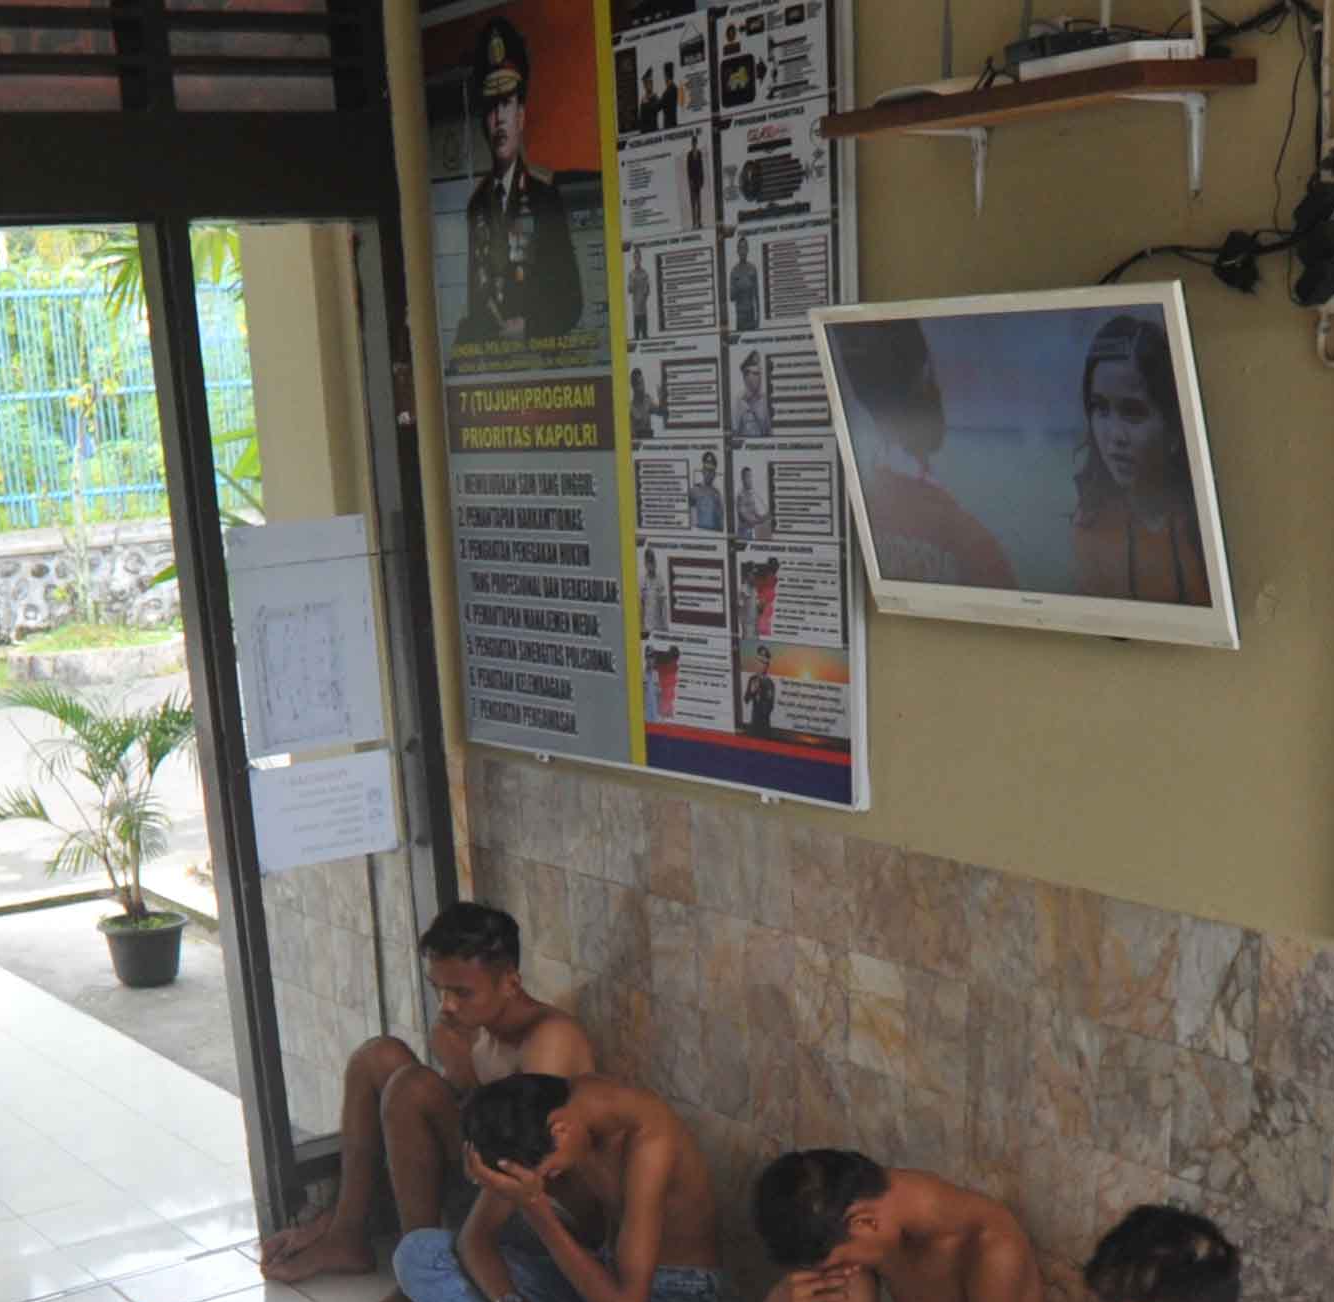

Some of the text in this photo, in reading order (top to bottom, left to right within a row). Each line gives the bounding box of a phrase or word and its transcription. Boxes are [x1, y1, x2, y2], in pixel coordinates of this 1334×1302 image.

[459, 392, 468, 414] 7
[461, 423, 599, 449] PRIORITAS KAPOLRI
